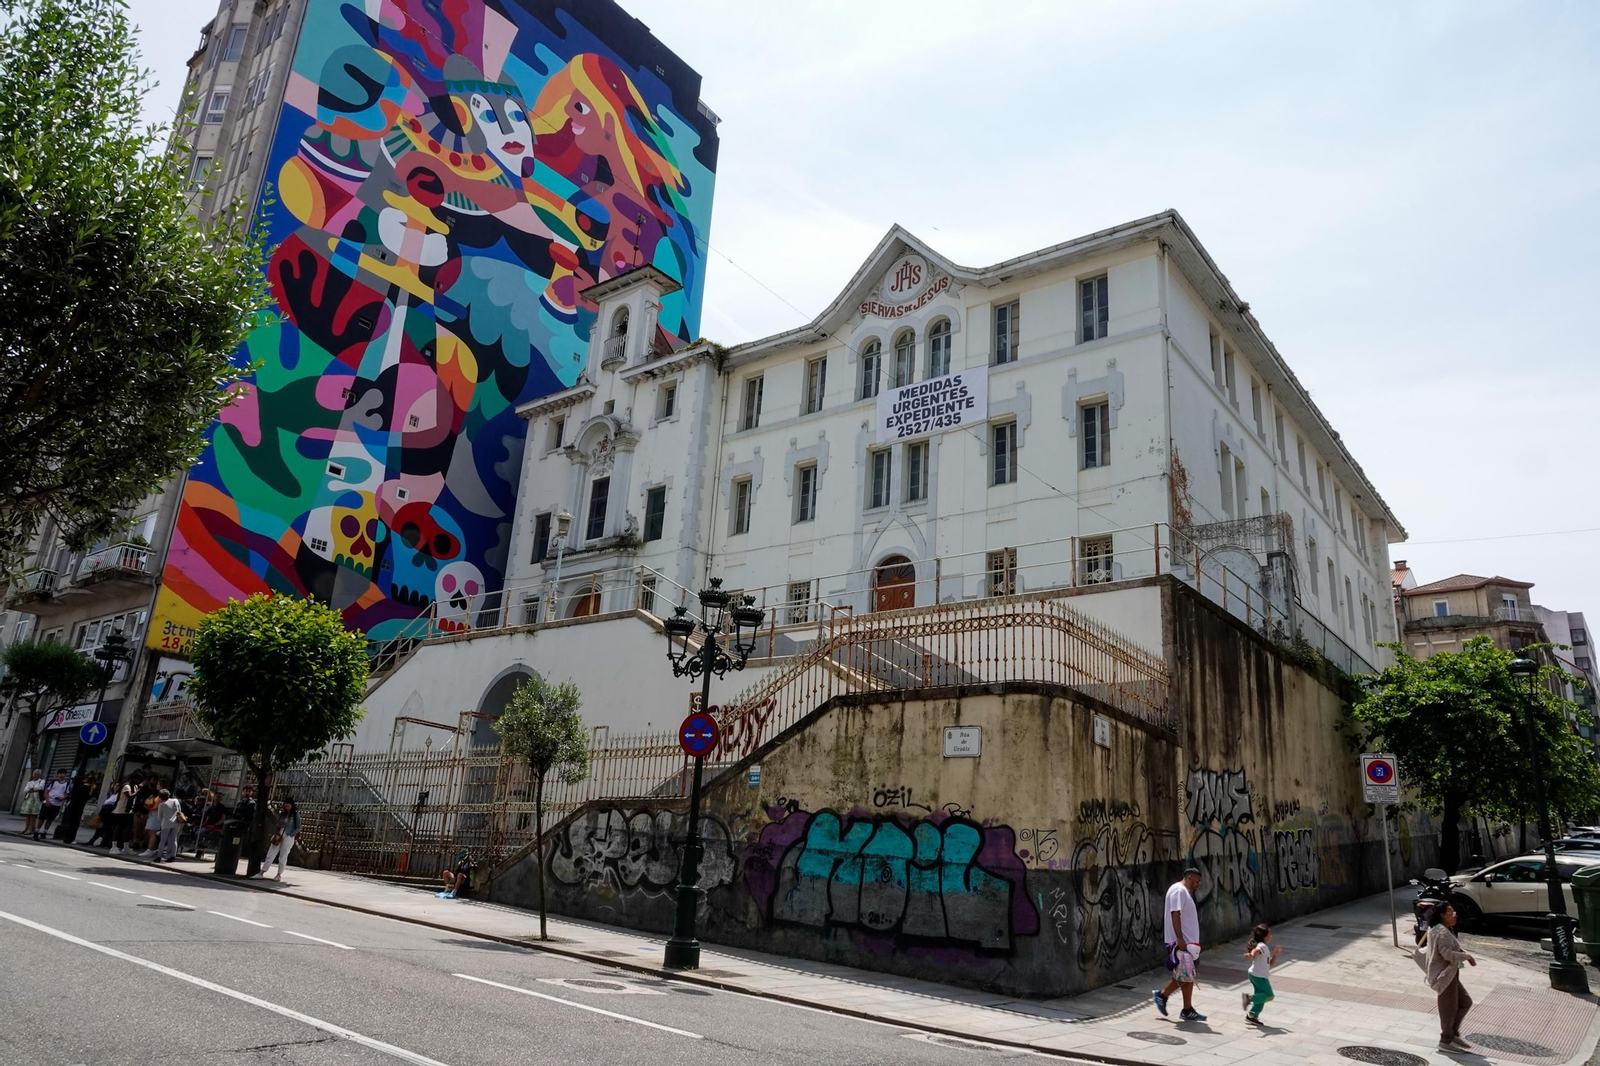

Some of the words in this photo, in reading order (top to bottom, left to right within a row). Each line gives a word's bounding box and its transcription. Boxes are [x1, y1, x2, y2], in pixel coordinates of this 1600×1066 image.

[861, 301, 903, 318] SIERVAS
[905, 304, 912, 313] DE
[914, 276, 949, 310] JESUS
[893, 386, 968, 414] URGENTES
[899, 375, 962, 401] MEDIDAS
[886, 396, 975, 429] EXPEDIENTE
[897, 412, 962, 438] 2527/435
[163, 620, 196, 638] 3ttm
